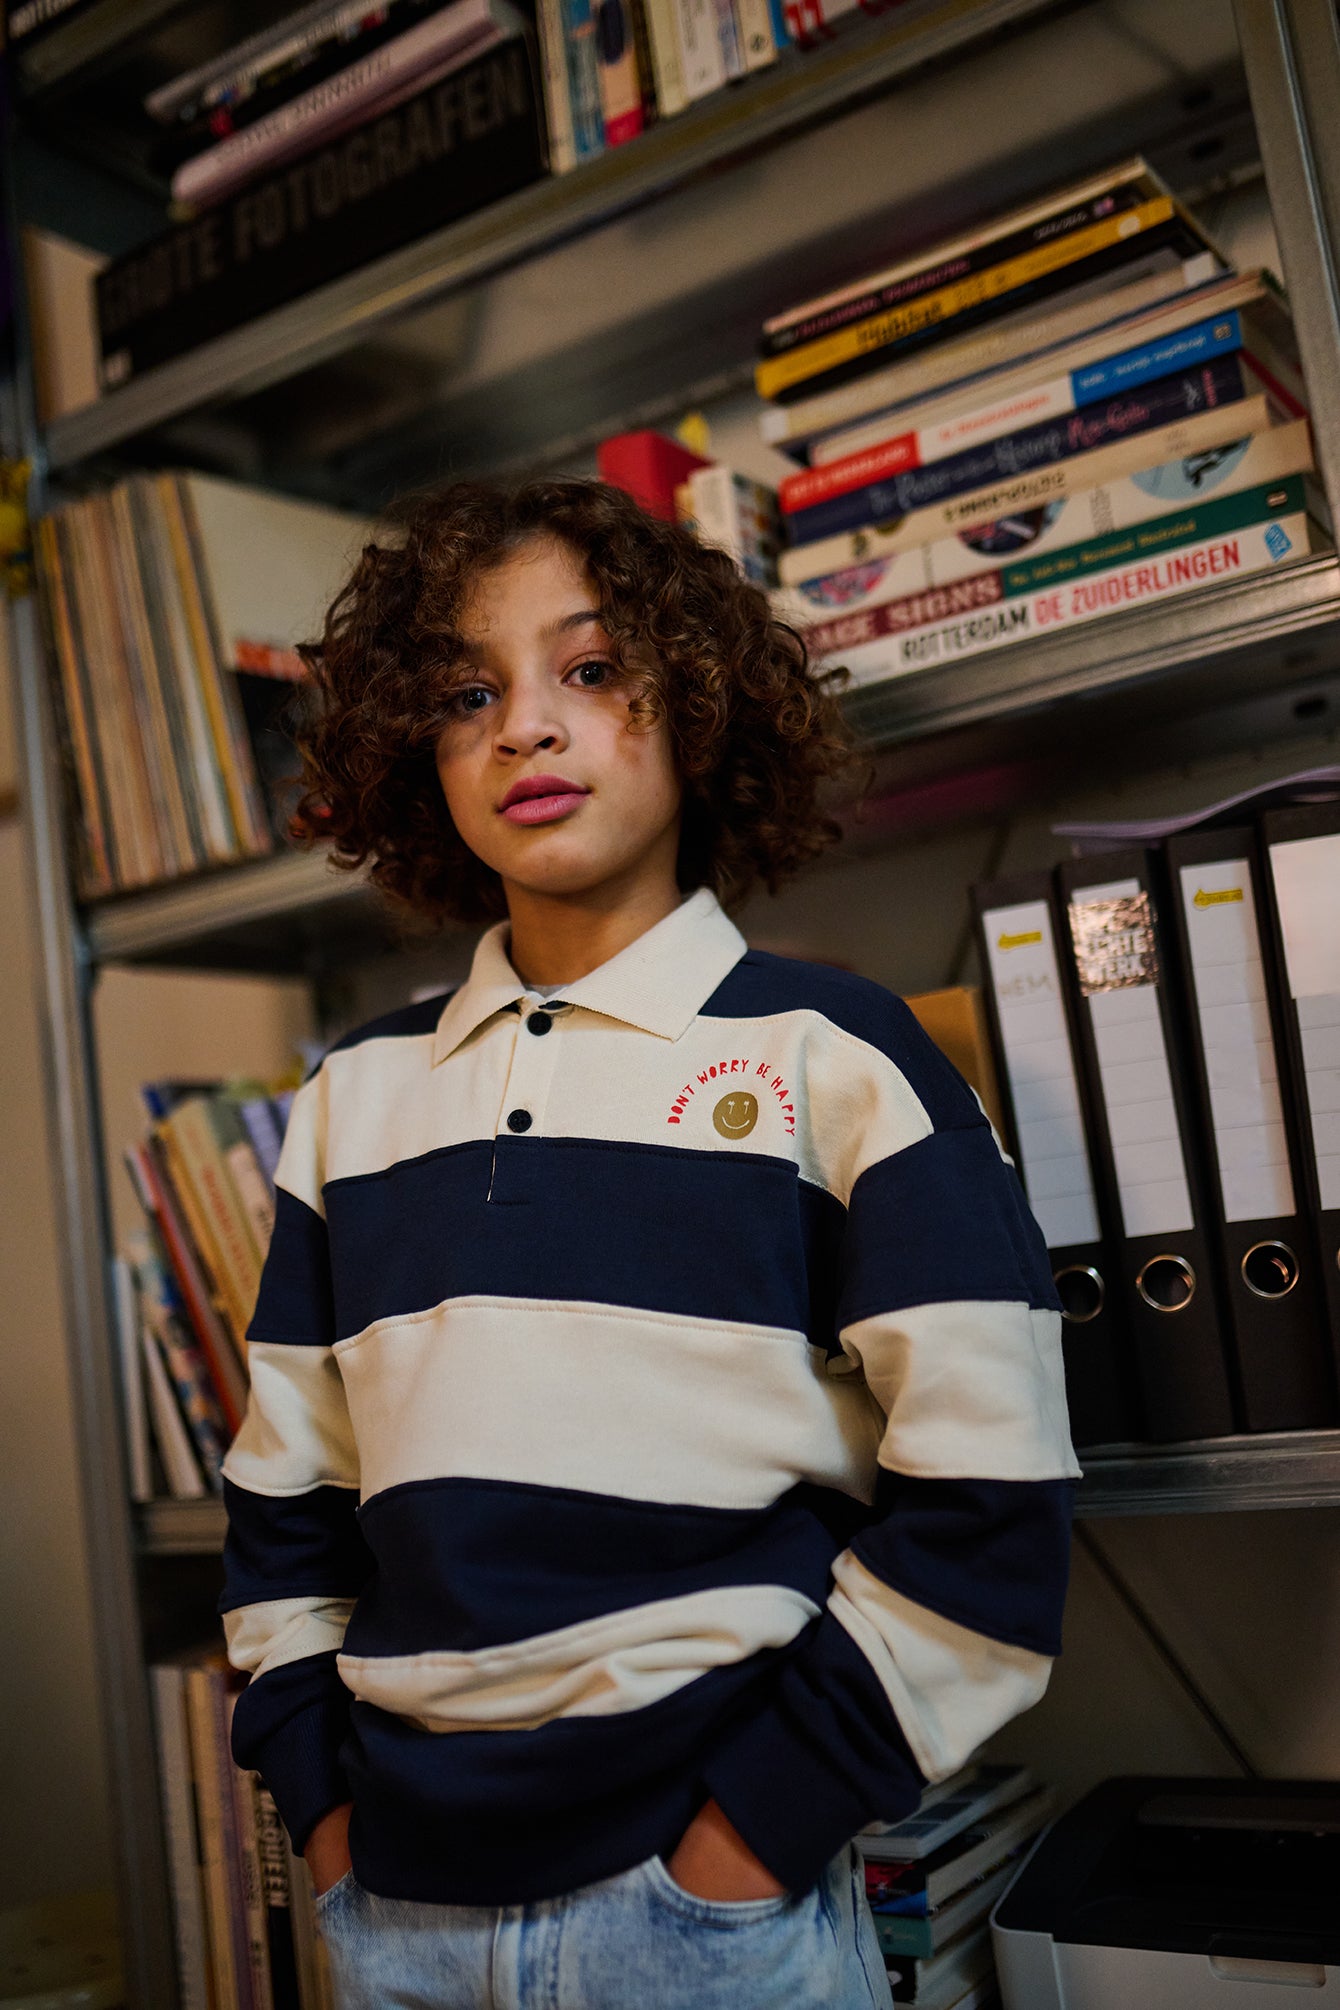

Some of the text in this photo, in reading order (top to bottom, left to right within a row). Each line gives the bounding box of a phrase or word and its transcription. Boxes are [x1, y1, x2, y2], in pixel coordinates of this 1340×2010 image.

[235, 46, 540, 267] FOTOGRAFEN
[888, 574, 1001, 630] SIGNS
[901, 605, 1030, 665] ROTTERDAM
[1034, 594, 1065, 626] DE
[1071, 539, 1241, 615] ZUIDERLINGEN
[667, 1059, 796, 1137] DON'T WORRY BE HAPPY
